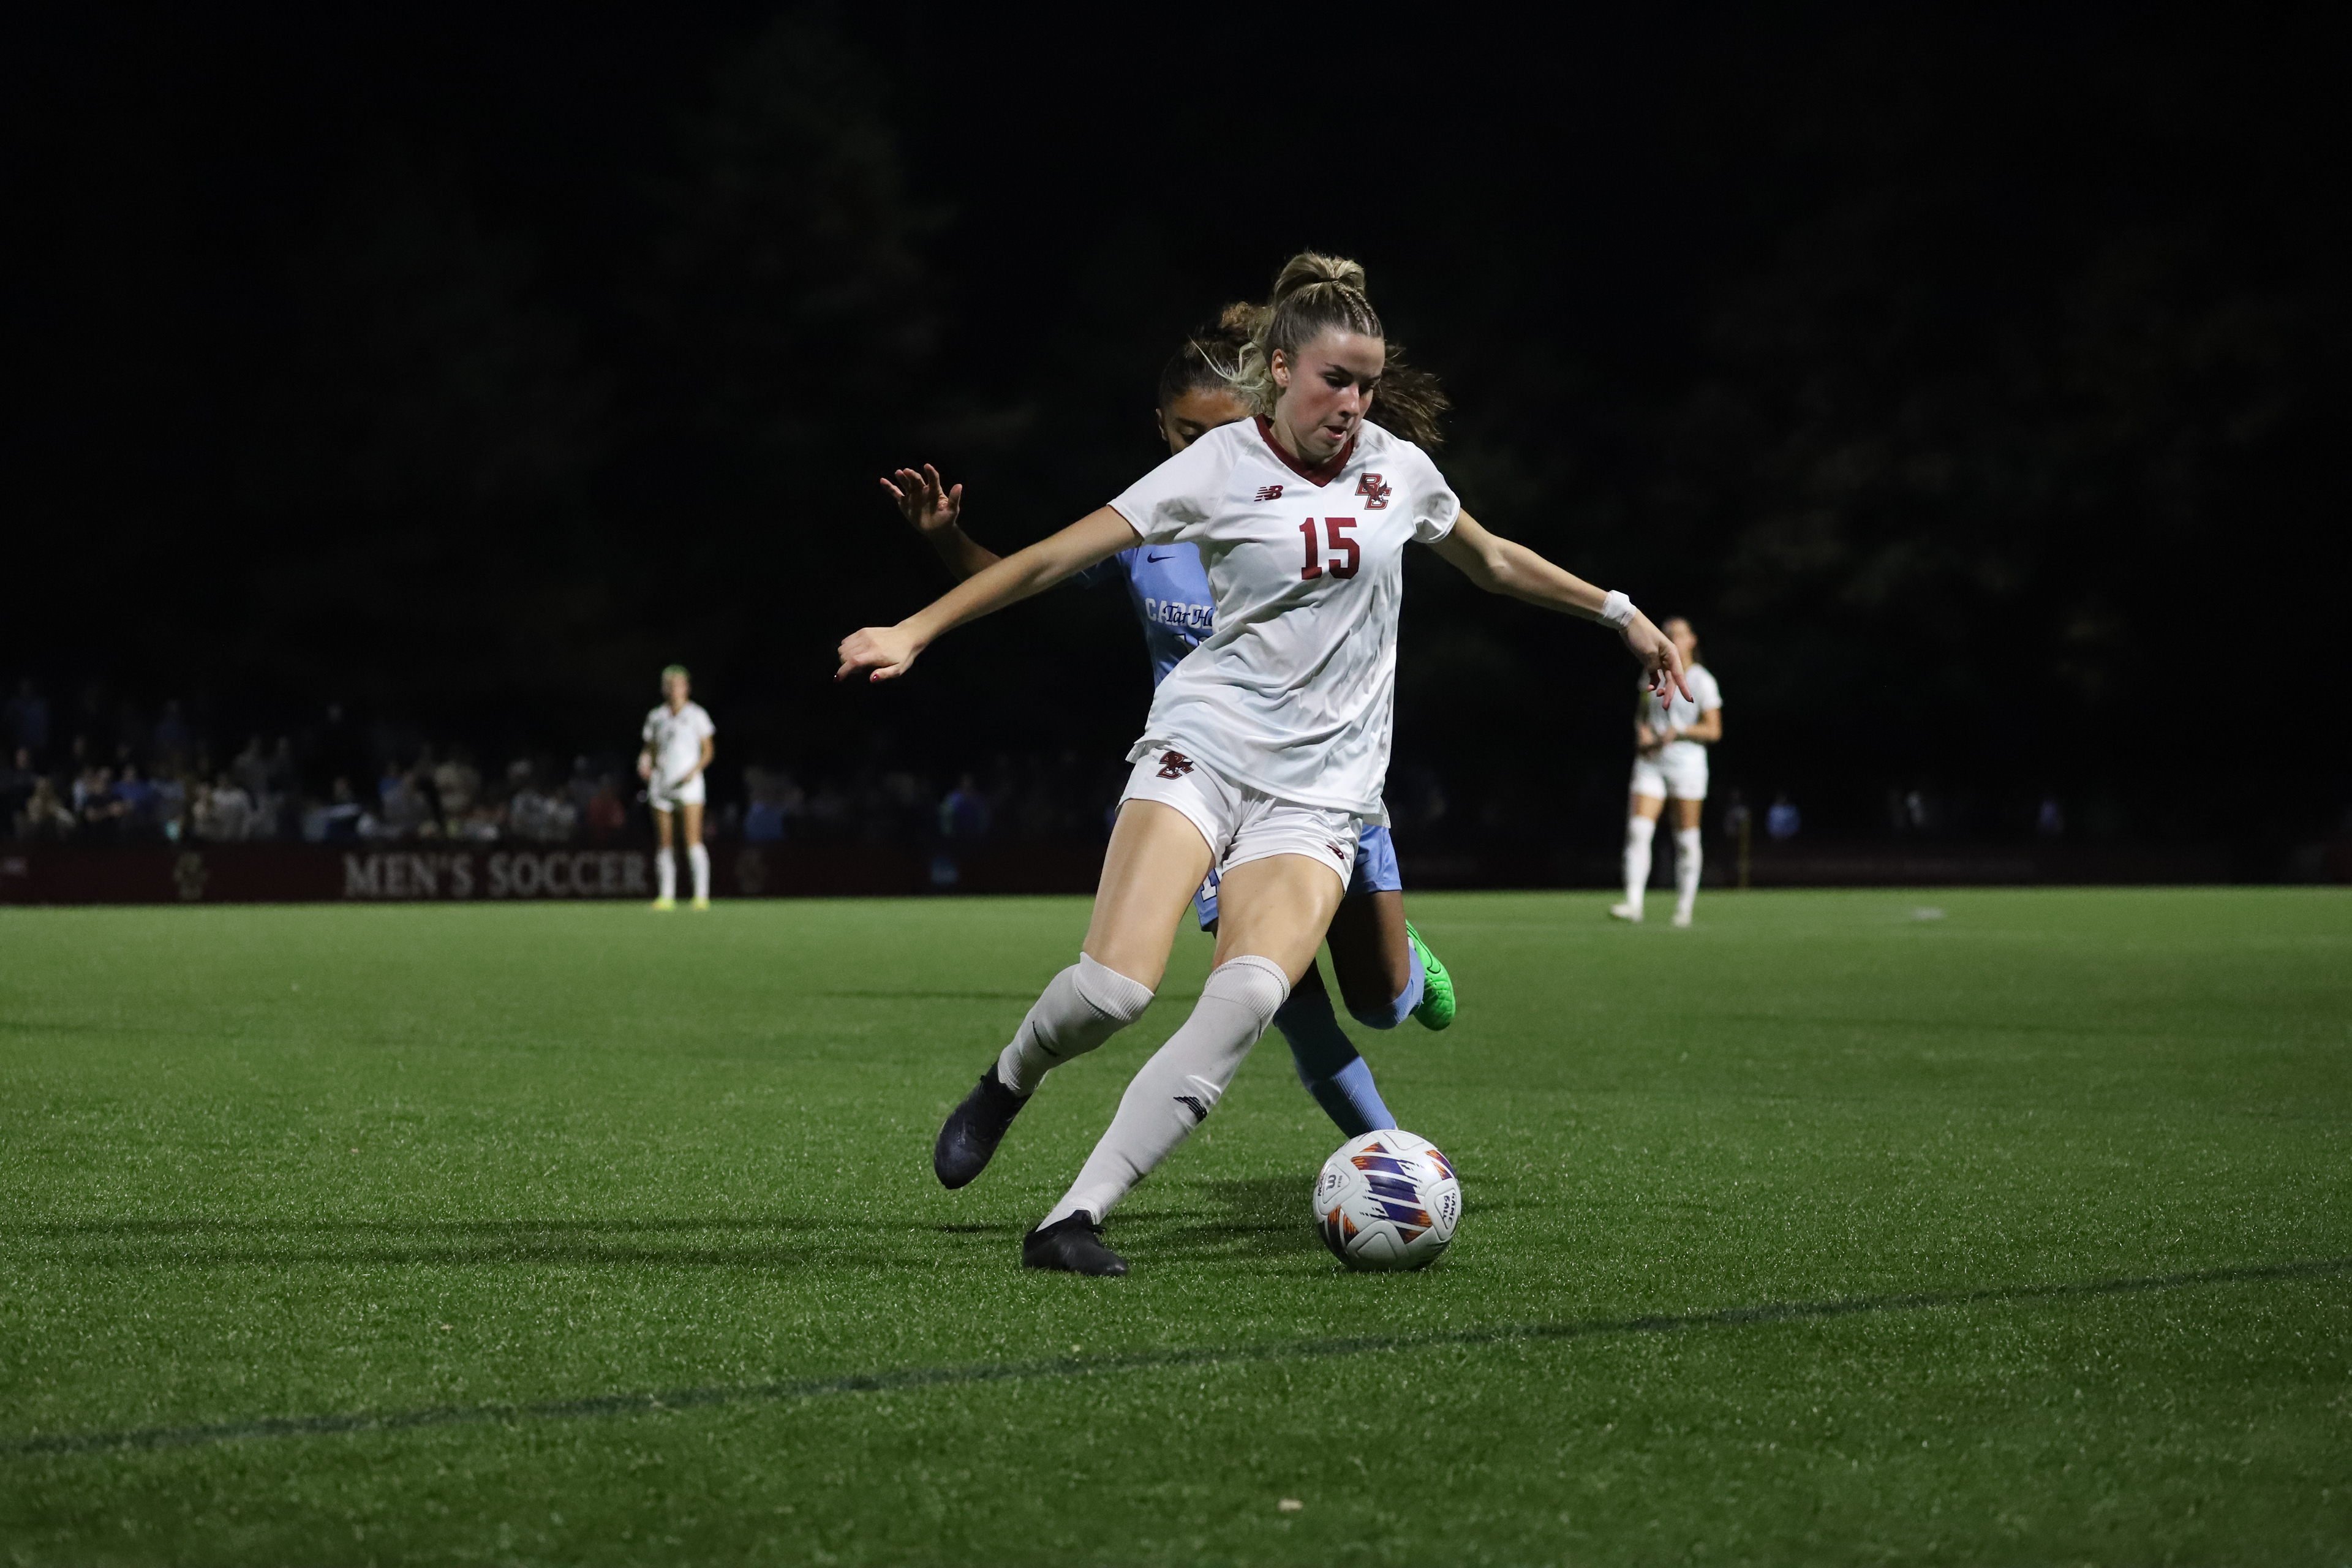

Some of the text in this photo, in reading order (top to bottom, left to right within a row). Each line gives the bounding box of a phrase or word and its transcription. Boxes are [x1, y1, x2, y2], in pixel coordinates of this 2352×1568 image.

[1299, 517, 1360, 579] 15
[1163, 605, 1191, 624] Tar
[344, 851, 648, 897] MEN'S SOCCER
